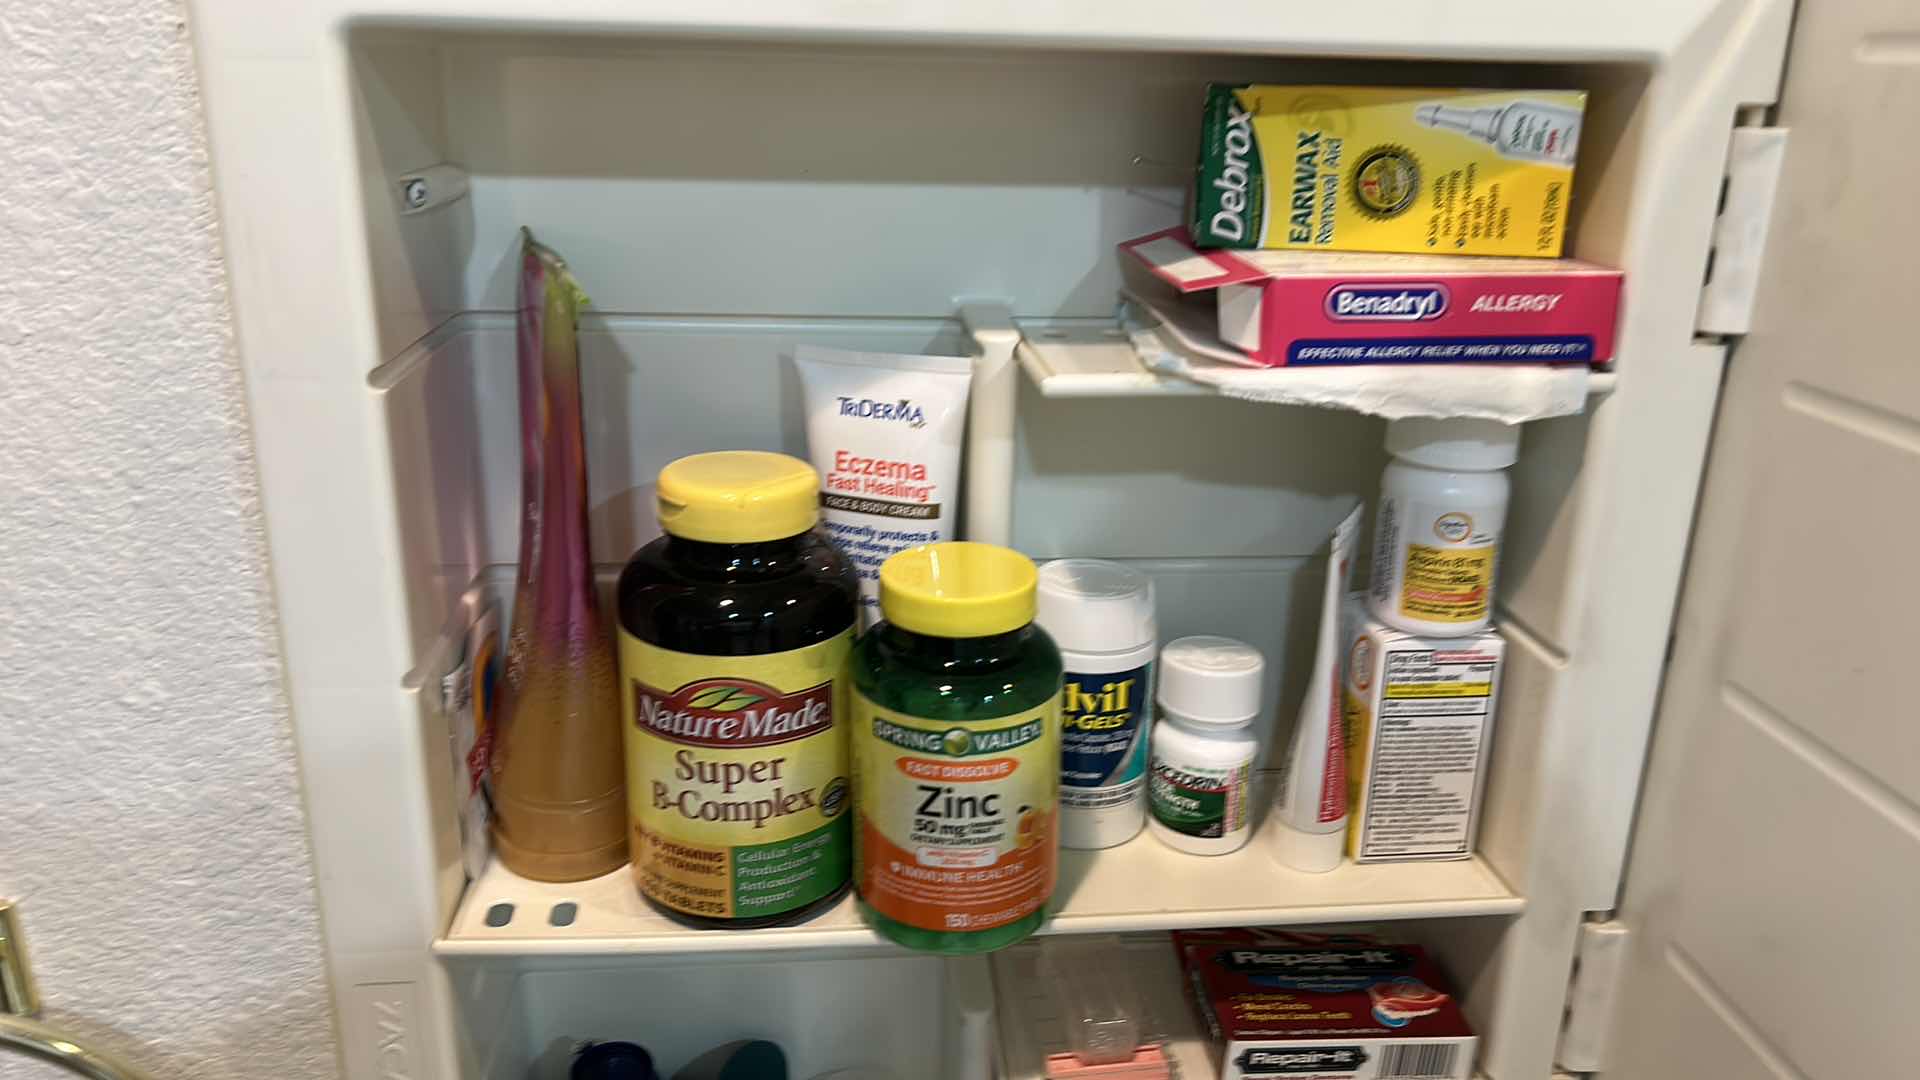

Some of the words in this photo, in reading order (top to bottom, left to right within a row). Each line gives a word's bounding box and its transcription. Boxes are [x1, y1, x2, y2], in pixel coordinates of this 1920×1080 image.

[1210, 102, 1254, 241] Debrox
[1288, 129, 1322, 244] EARWAX
[1315, 173, 1339, 245] Removal
[1328, 137, 1343, 170] Aid
[1336, 290, 1440, 320] Benadryl
[1469, 293, 1564, 313] ALLERGY
[1297, 346, 1364, 360] EFFECTIVE
[1364, 346, 1420, 359] ALLERGY
[1421, 346, 1463, 358] RELIEF
[1464, 345, 1502, 357] WHEN
[1502, 344, 1527, 356] YOU
[1527, 344, 1560, 356] NEED
[833, 450, 928, 481] Eczema
[826, 473, 861, 491] Fast
[825, 495, 852, 508] FACE
[858, 501, 888, 513] BODY
[888, 503, 931, 517] CREAM
[638, 694, 738, 739] Nature
[737, 697, 827, 739] Made
[873, 719, 943, 752] SPRING
[972, 722, 1043, 751] VALLEY
[674, 749, 787, 794] Super
[906, 760, 940, 776] FAST
[942, 761, 1010, 777] DISSOLVE
[651, 779, 817, 829] B-Complex
[916, 784, 1000, 818] Zinc
[914, 818, 936, 834] 50
[939, 823, 967, 837] mg
[736, 847, 790, 864] Cellular
[736, 857, 808, 878] Production
[901, 865, 964, 882] IMMUNE
